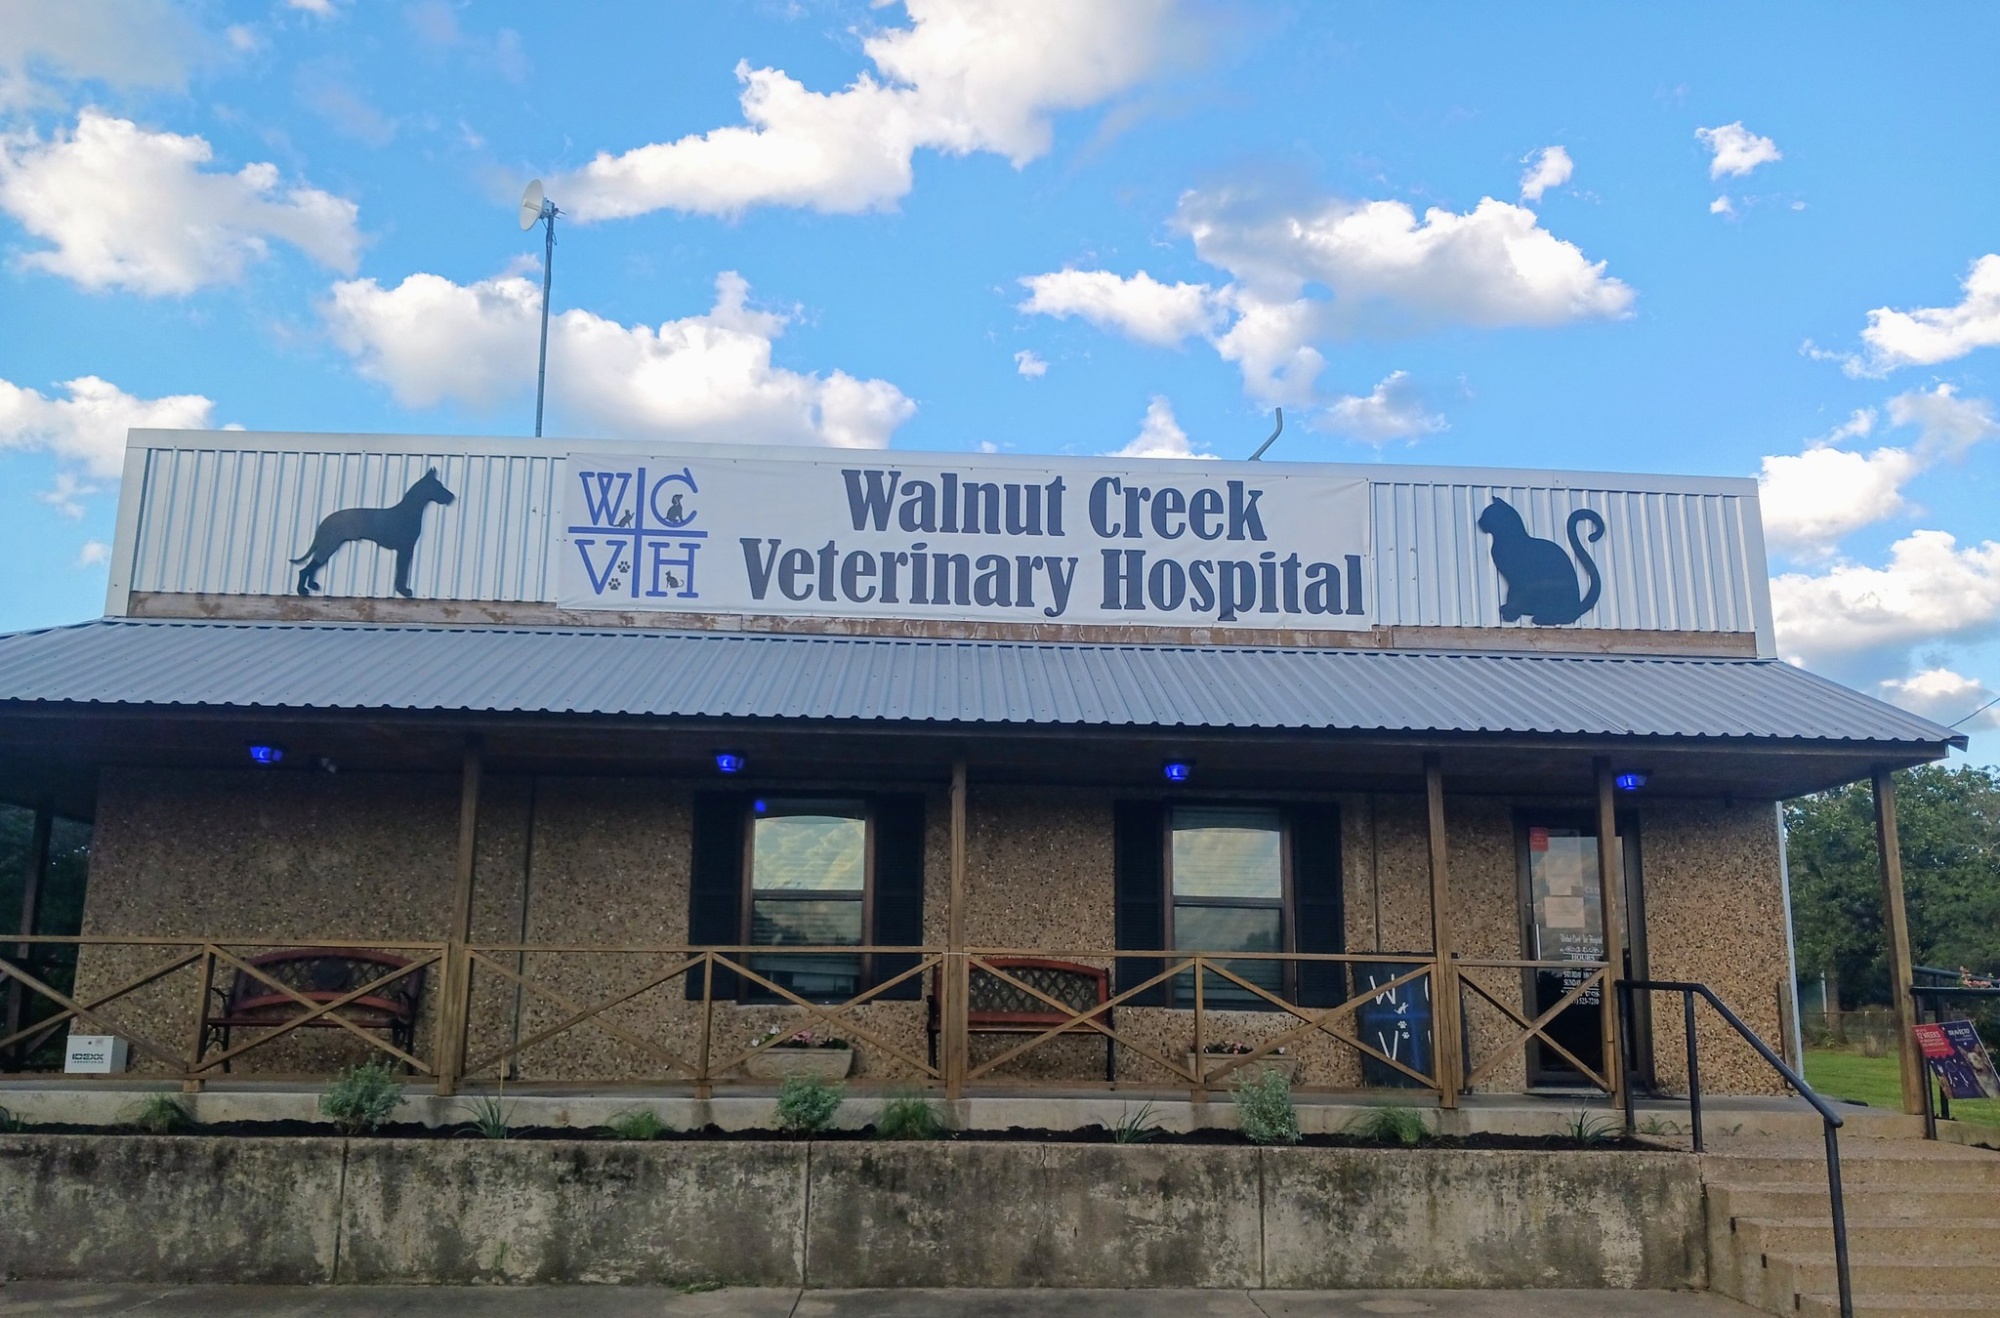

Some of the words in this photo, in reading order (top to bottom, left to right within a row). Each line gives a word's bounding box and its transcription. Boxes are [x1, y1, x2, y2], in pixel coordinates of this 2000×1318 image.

[841, 469, 1067, 537] Walnut
[1088, 476, 1268, 541] Creek
[739, 537, 1079, 617] Veterinary
[1100, 549, 1365, 622] Hospital
